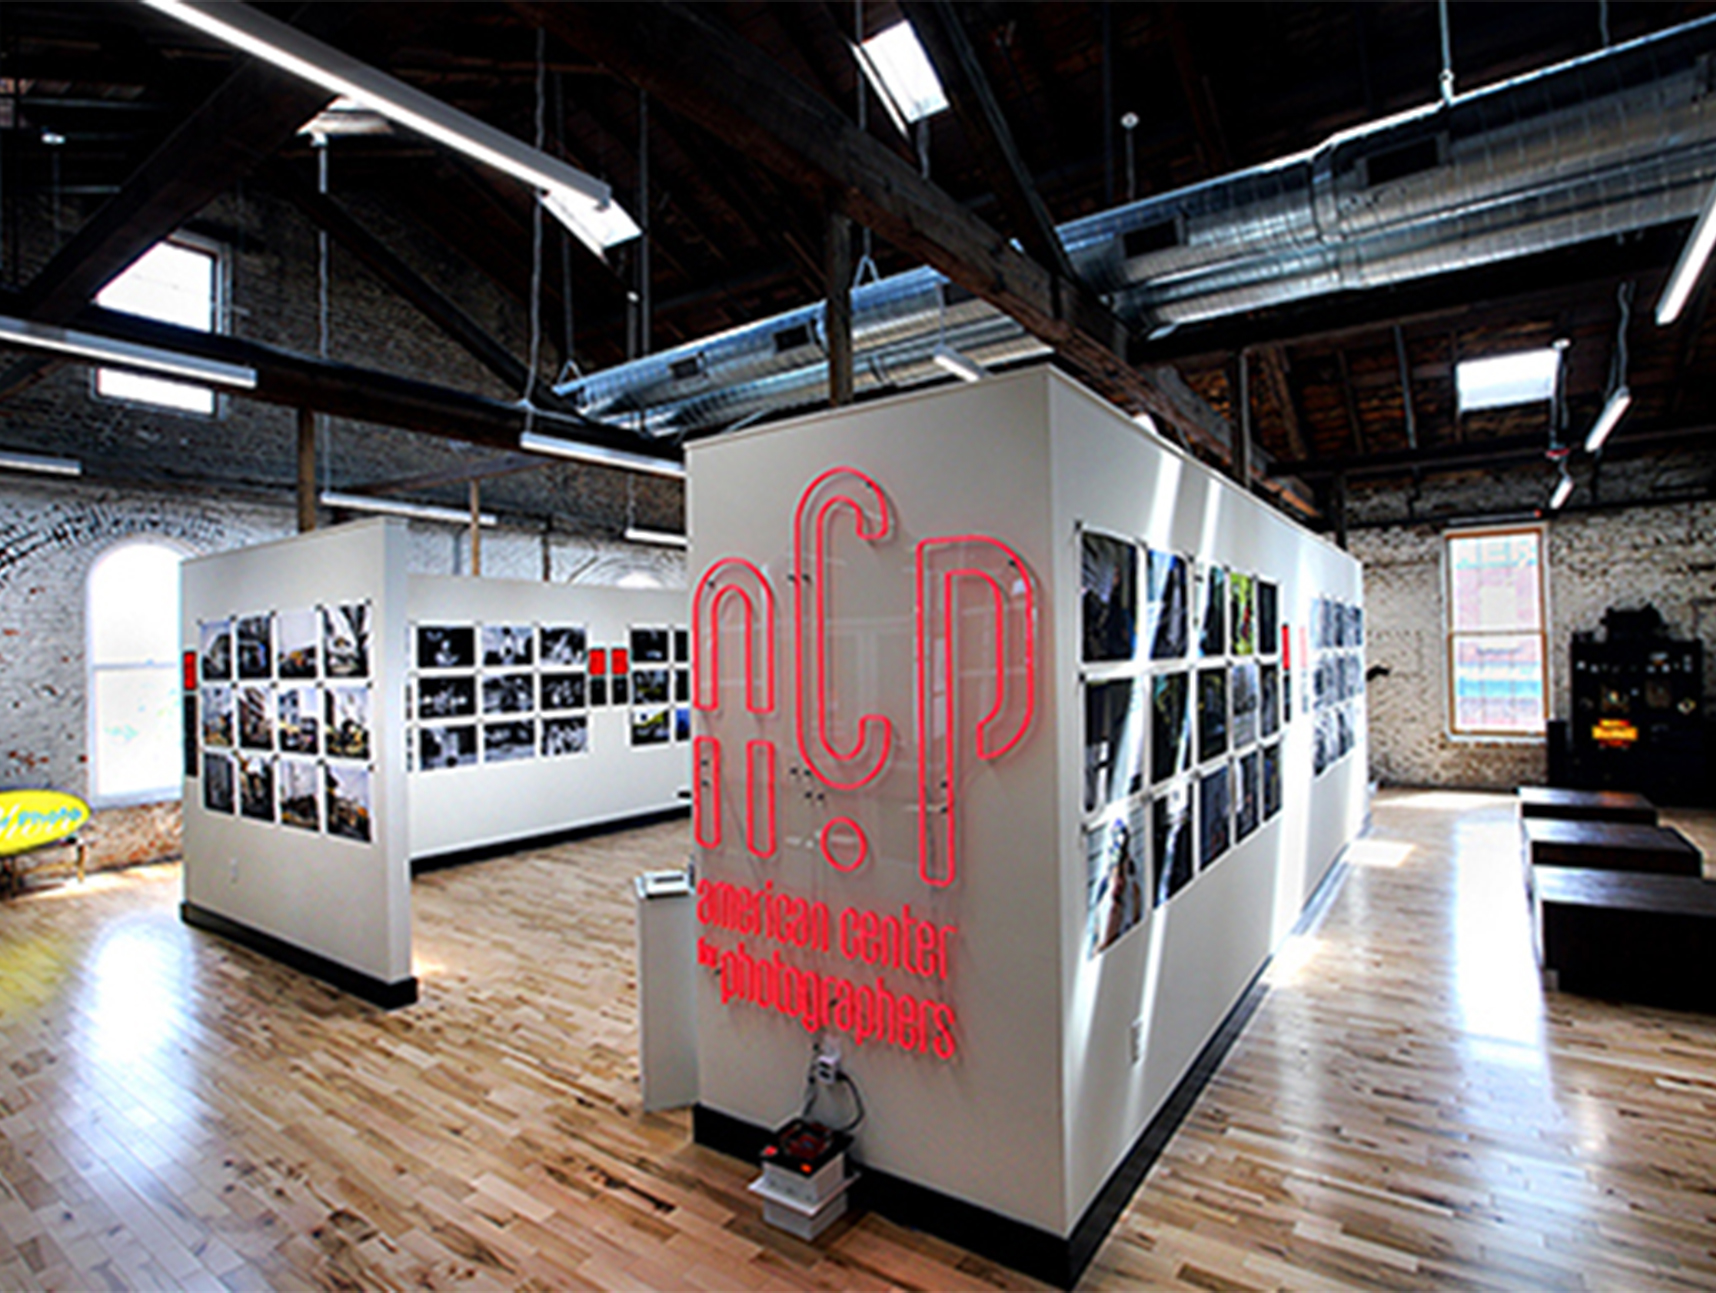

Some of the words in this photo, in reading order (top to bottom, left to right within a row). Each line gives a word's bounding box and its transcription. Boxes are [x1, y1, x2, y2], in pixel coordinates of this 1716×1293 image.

[696, 878, 831, 955] american
[838, 903, 958, 981] center
[719, 940, 957, 1060] photographers
